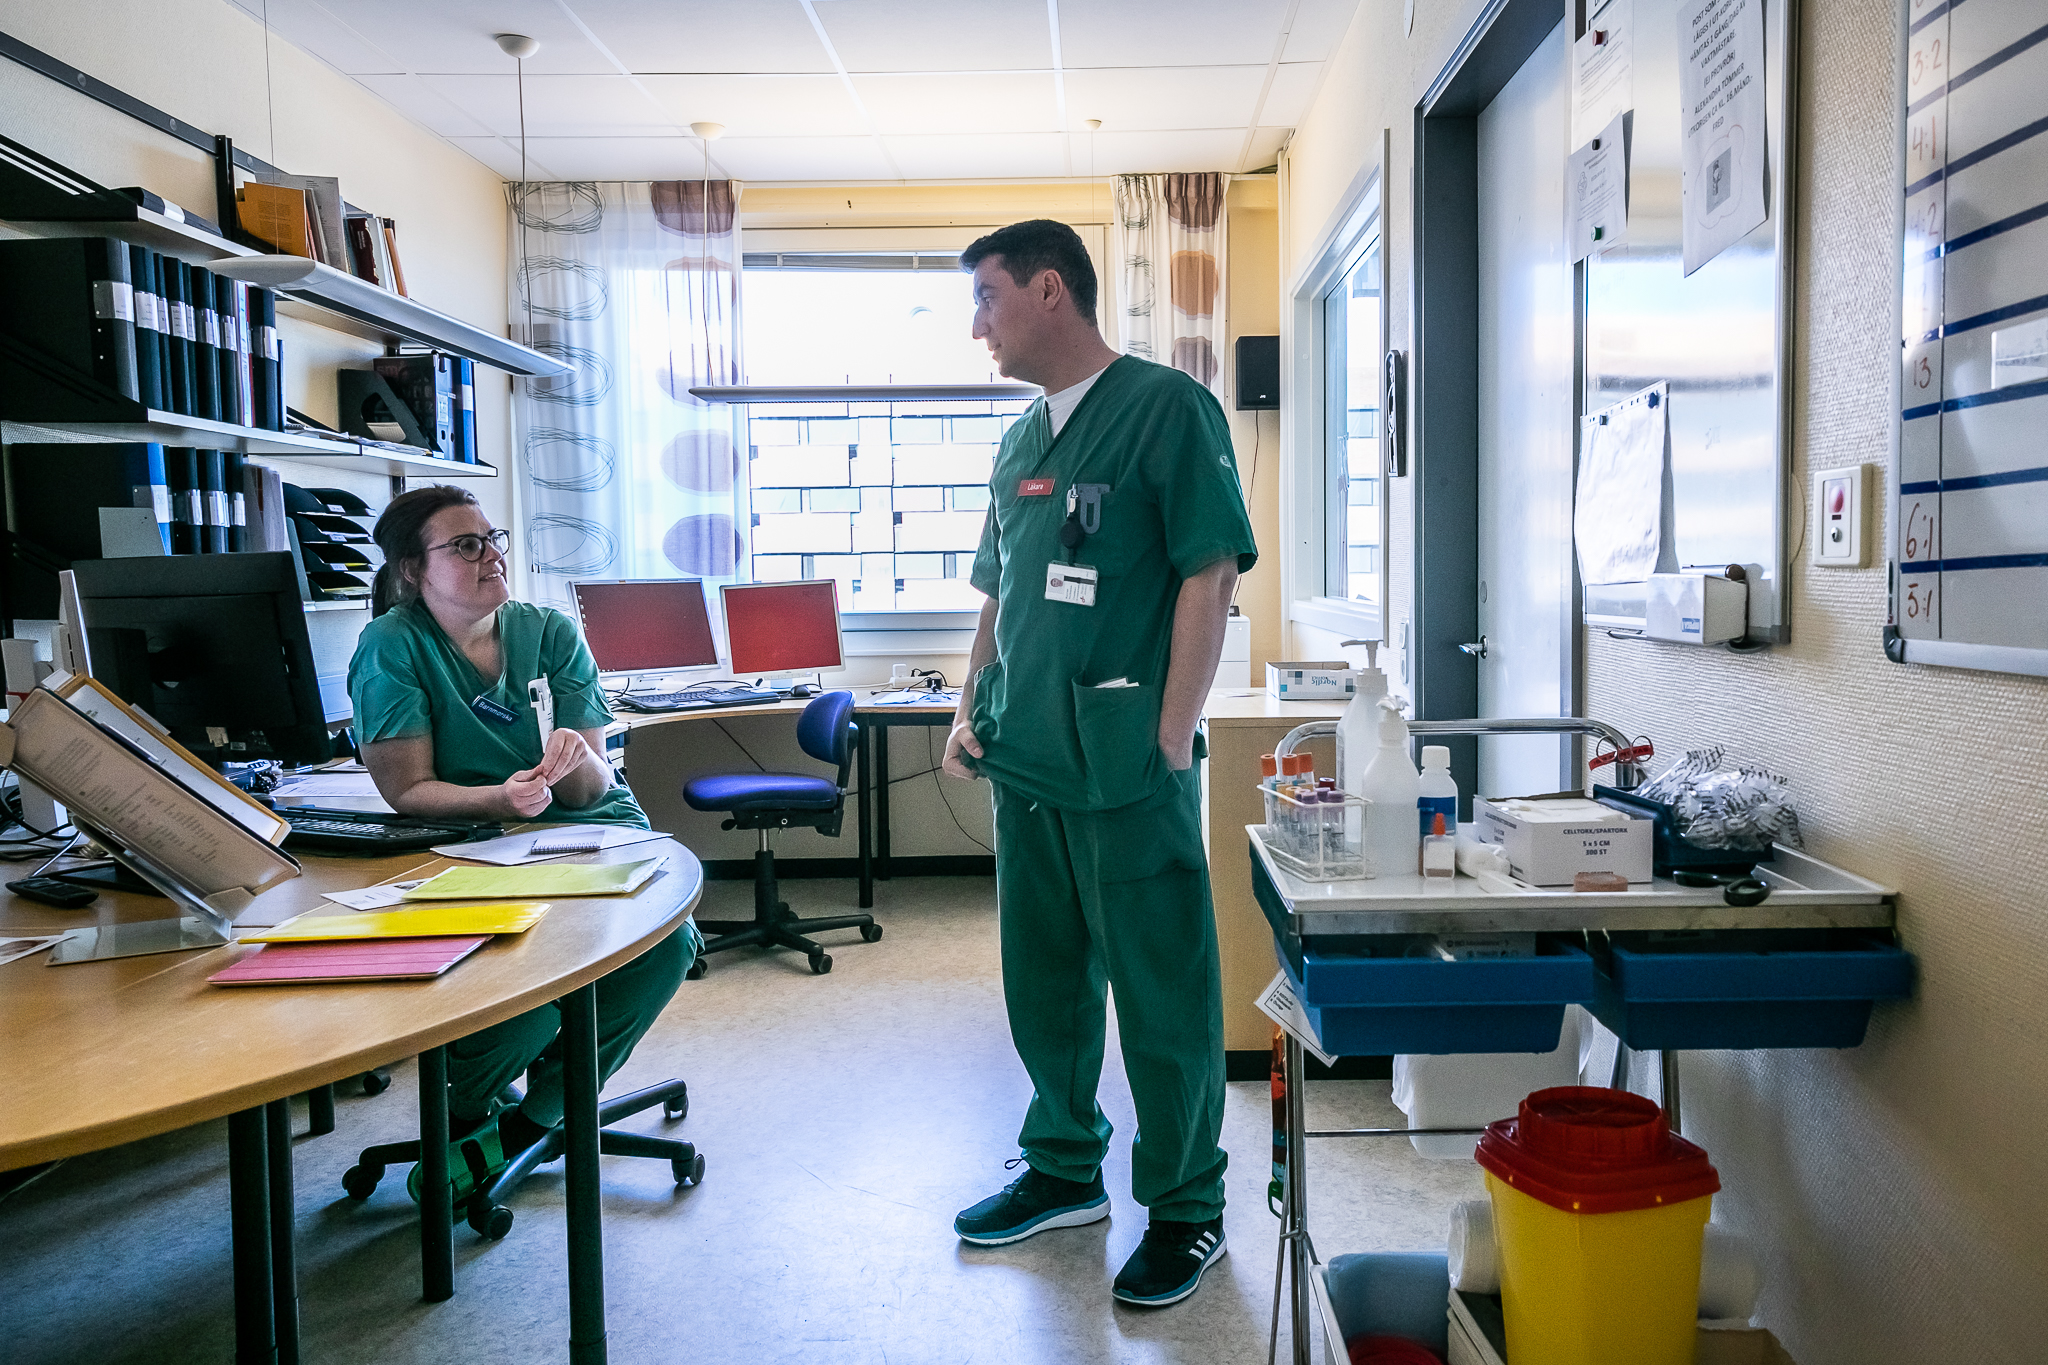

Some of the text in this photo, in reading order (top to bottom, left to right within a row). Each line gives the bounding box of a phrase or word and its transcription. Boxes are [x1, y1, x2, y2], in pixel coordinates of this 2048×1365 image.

[1692, 10, 1704, 28] POST
[1693, 22, 1709, 43] LÄGGS
[1690, 38, 1709, 63] HÄMTAS
[1912, 38, 1942, 86] 3:2
[1694, 62, 1744, 116] ALEXANDRA TÖMMER
[1712, 116, 1724, 132] FRED
[1912, 115, 1936, 160] 4:1
[1913, 356, 1932, 389] 13
[1027, 483, 1044, 491] Läkare
[1905, 502, 1934, 561] 6:1
[1907, 583, 1933, 619] 5:1
[478, 701, 513, 722] Barnmorska
[1563, 827, 1628, 835] CELLTORK/SPARTORK
